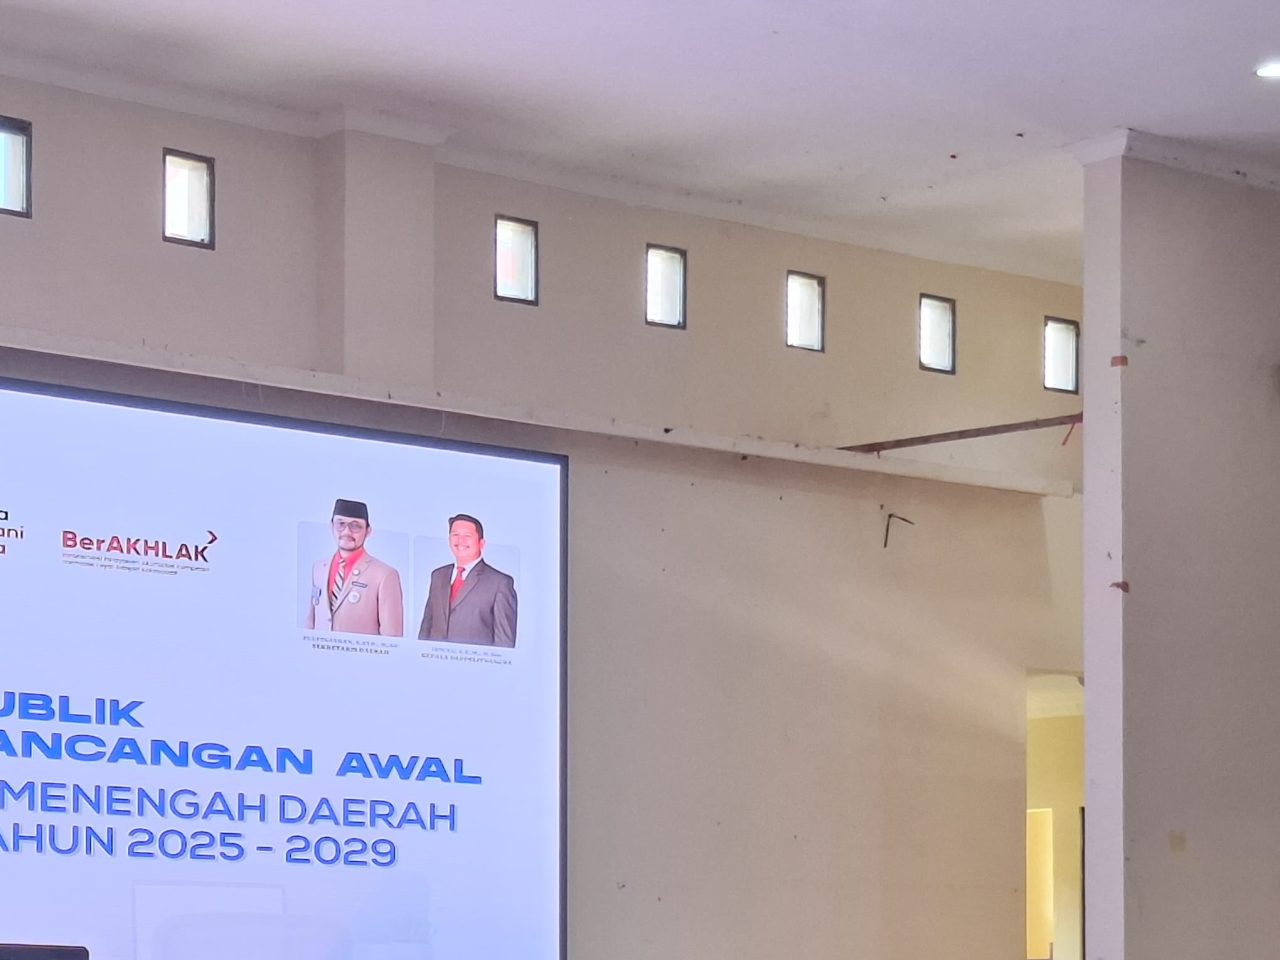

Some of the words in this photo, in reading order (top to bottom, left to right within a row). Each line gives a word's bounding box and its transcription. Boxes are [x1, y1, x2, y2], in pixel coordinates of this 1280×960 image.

[62, 530, 208, 562] BerAKHLAK
[336, 752, 482, 784] AWAL
[279, 794, 456, 831] DAERAH
[128, 828, 245, 861] 2025
[286, 835, 396, 867] 2029
